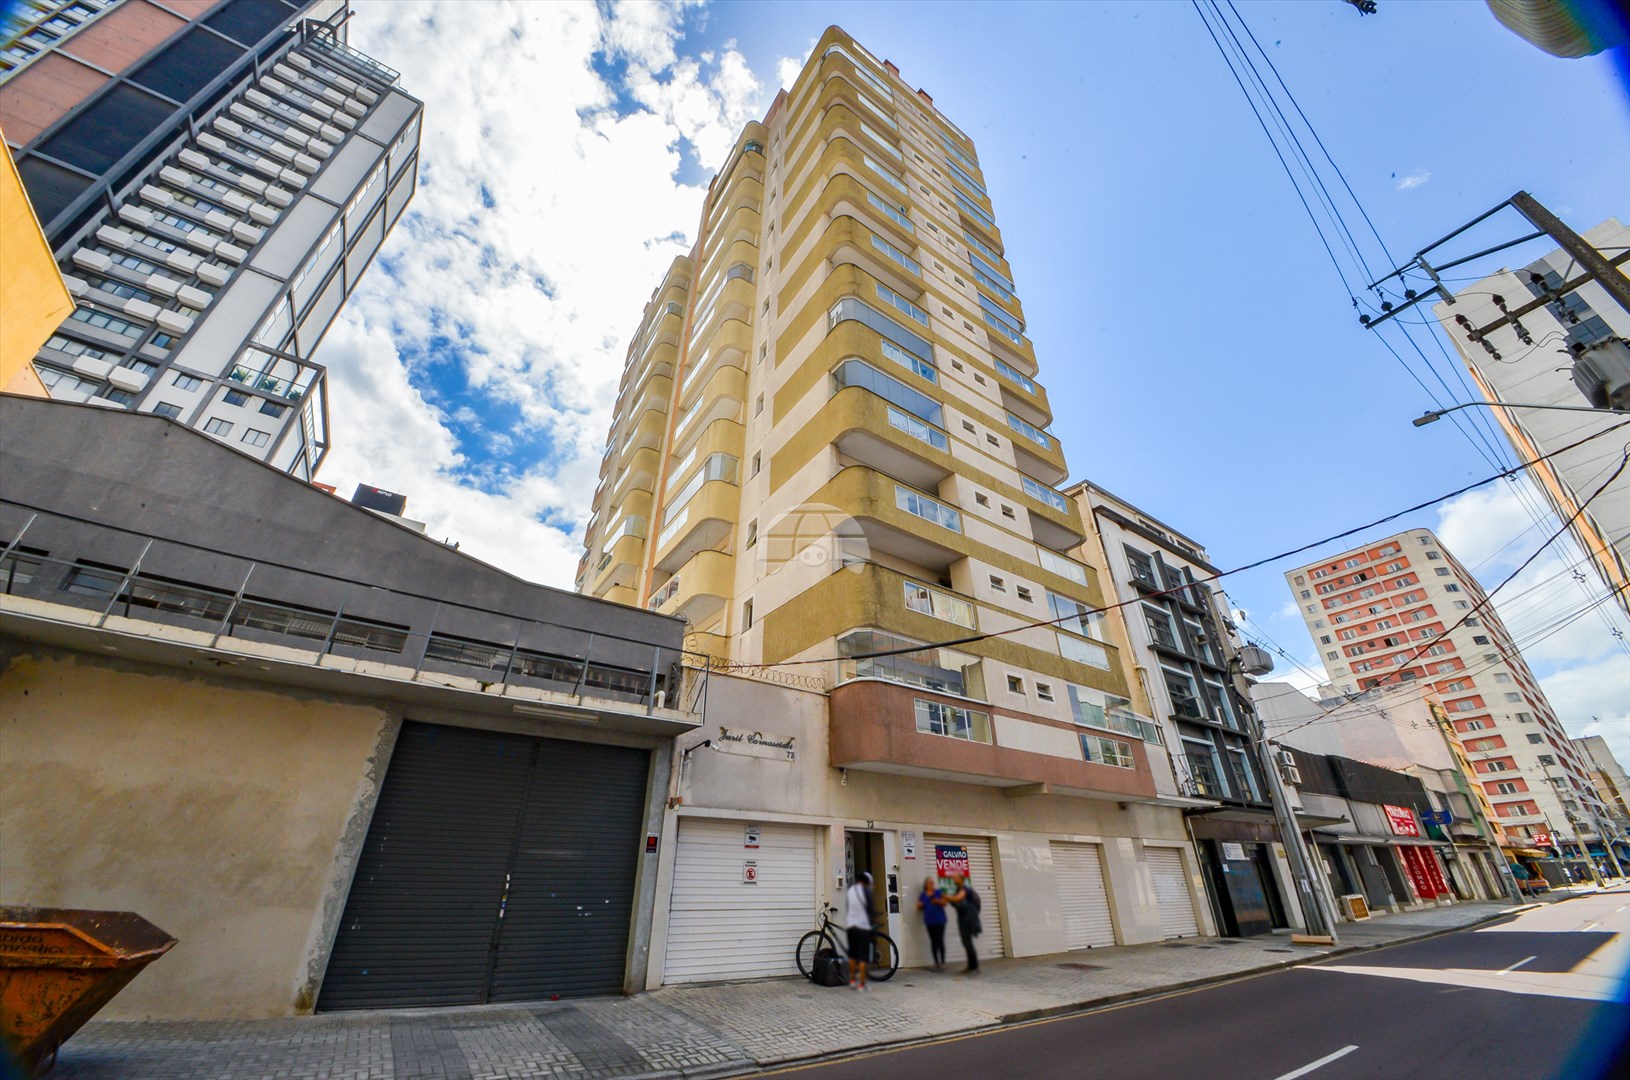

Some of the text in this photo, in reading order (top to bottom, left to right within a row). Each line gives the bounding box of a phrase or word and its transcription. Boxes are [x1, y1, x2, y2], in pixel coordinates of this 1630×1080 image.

[786, 751, 795, 759] 73
[866, 820, 874, 829] 73
[937, 859, 969, 871] VENDE
